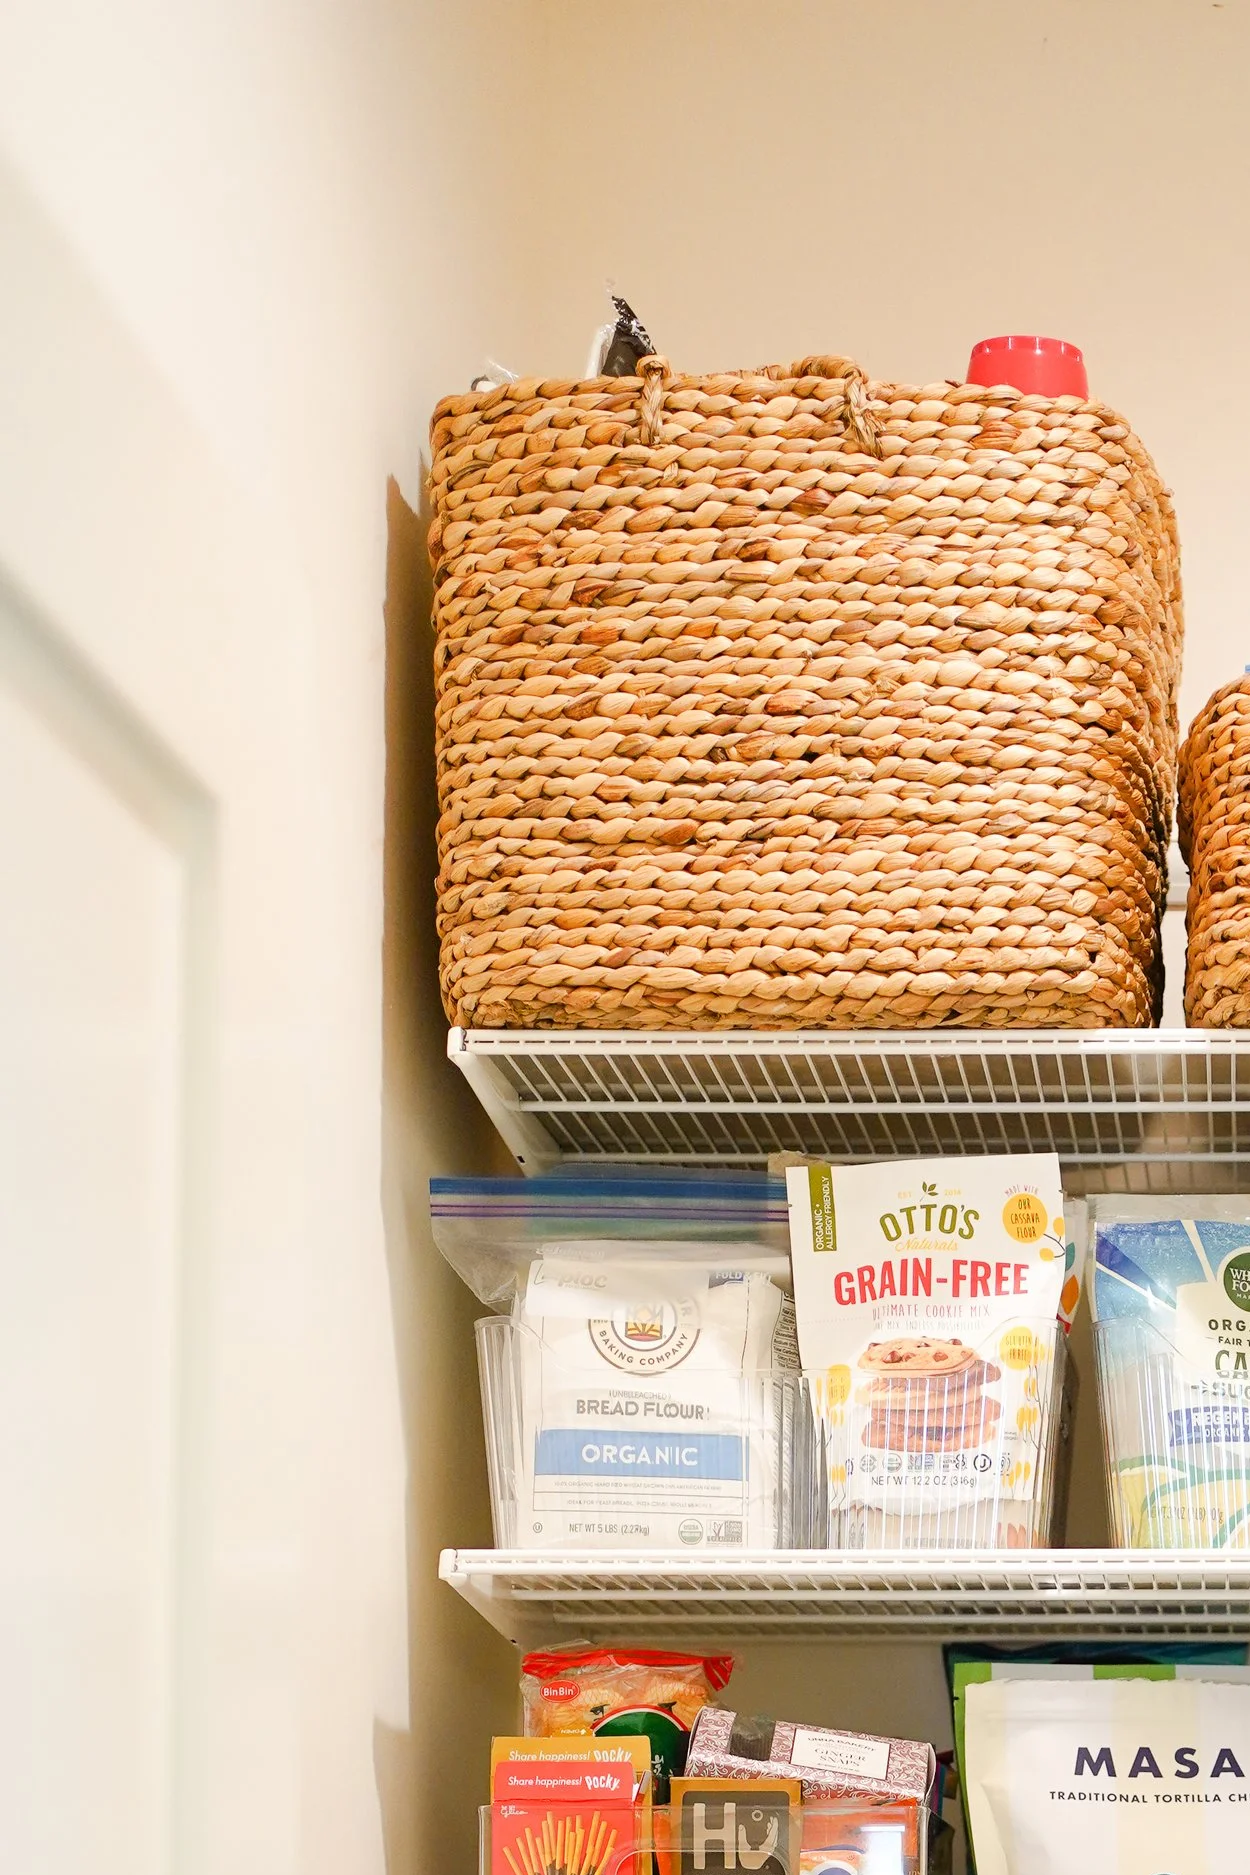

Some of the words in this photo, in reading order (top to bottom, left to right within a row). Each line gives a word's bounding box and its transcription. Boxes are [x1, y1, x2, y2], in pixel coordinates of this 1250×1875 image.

[879, 1204, 979, 1242] OTTO'S
[1010, 1212, 1040, 1224] CASSAVA
[816, 1209, 824, 1250] ORGANIC
[834, 1258, 1029, 1306] GRAIN-FREE
[600, 1330, 634, 1363] BAKING
[639, 1334, 687, 1365] COMPANY
[1218, 1336, 1242, 1346] FAIR
[543, 1687, 574, 1696] BinBin
[509, 1751, 536, 1761] Share
[539, 1751, 590, 1762] happiness!
[1074, 1747, 1245, 1778] MASA
[1050, 1791, 1147, 1803] TRADITIONAL
[1154, 1793, 1221, 1803] TORTILLA
